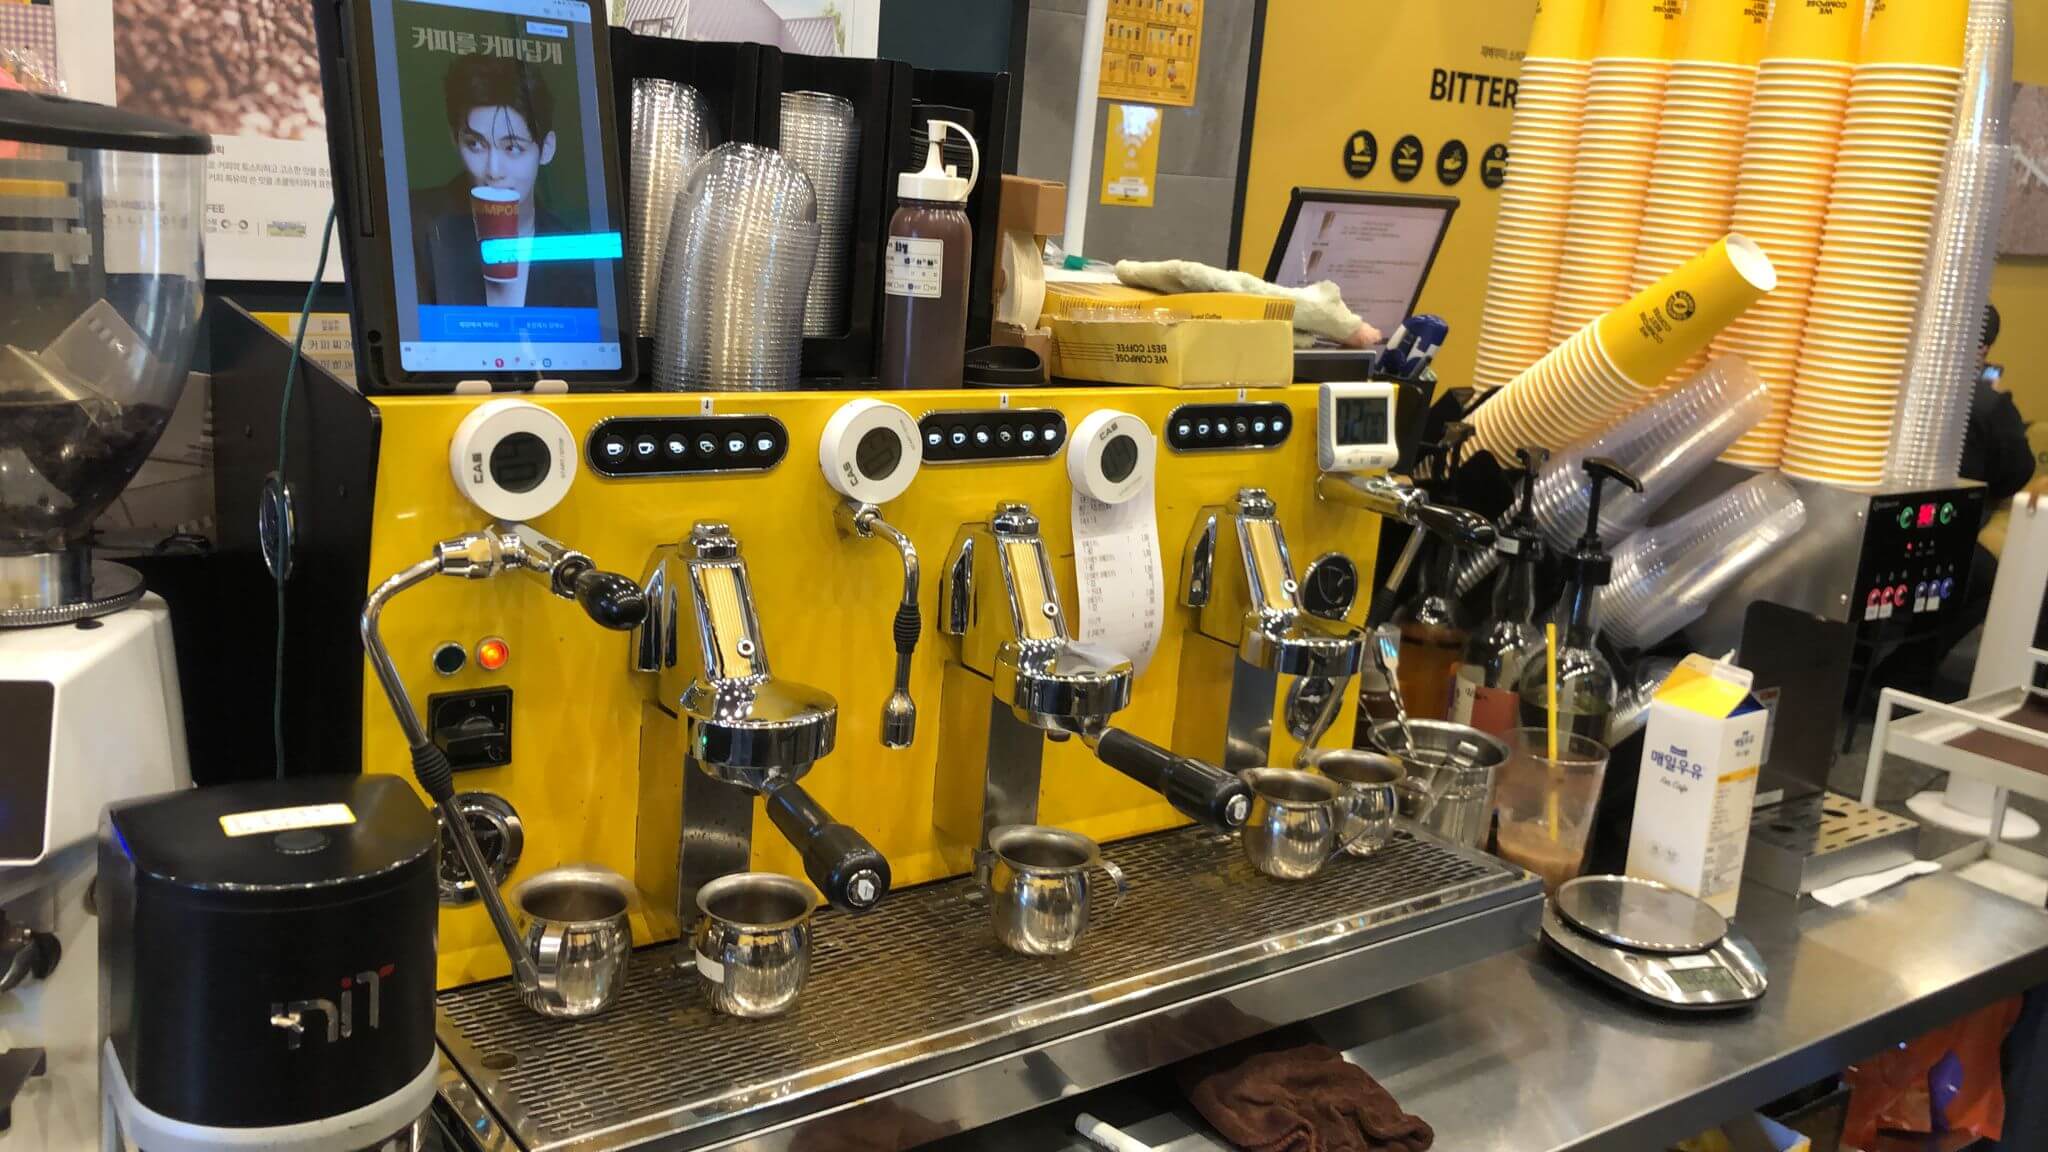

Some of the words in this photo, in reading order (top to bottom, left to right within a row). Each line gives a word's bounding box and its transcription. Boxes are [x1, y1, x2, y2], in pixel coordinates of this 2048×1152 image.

[411, 26, 478, 56] 커피를
[480, 34, 563, 65] 커피답게
[1430, 68, 1520, 109] BITTER
[1115, 353, 1153, 364] COMPOSE
[1116, 343, 1145, 353] COFFEE
[1147, 344, 1167, 353] BEST
[1154, 354, 1169, 365] WE
[1100, 422, 1119, 441] CAS
[471, 452, 485, 485] CAS
[843, 461, 859, 487] CAS
[1651, 750, 1704, 781] 매일우유
